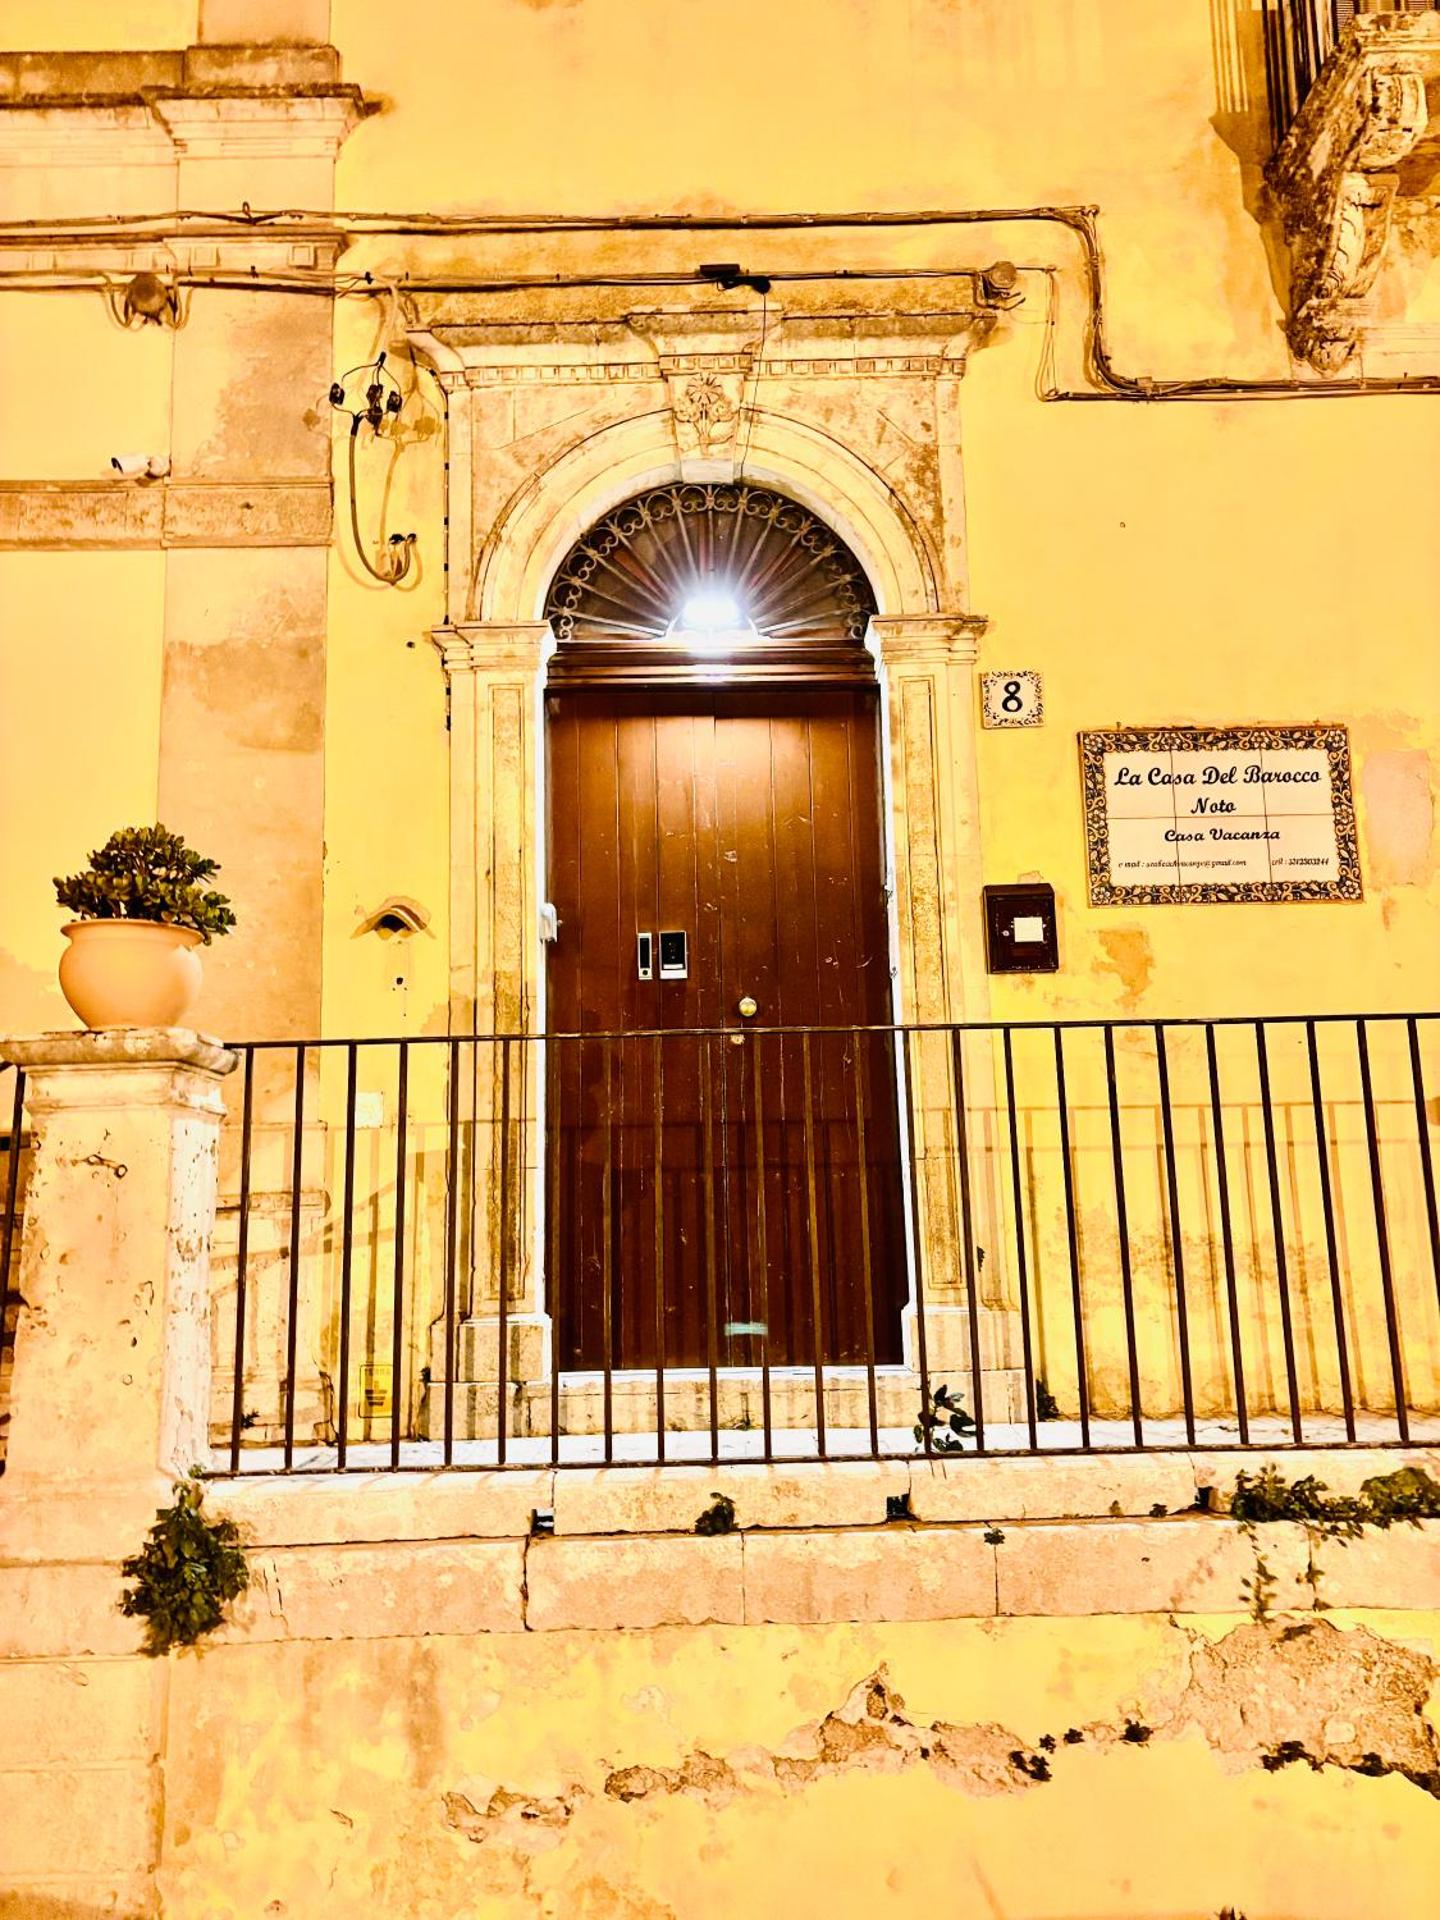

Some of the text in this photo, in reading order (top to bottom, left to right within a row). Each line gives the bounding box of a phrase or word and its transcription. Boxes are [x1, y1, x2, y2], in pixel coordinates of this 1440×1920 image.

[1001, 680, 1024, 713] 8
[1114, 766, 1321, 786] La Casa Del Barocco
[1191, 797, 1236, 814] Noto
[1164, 828, 1280, 842] Casa Vacanza
